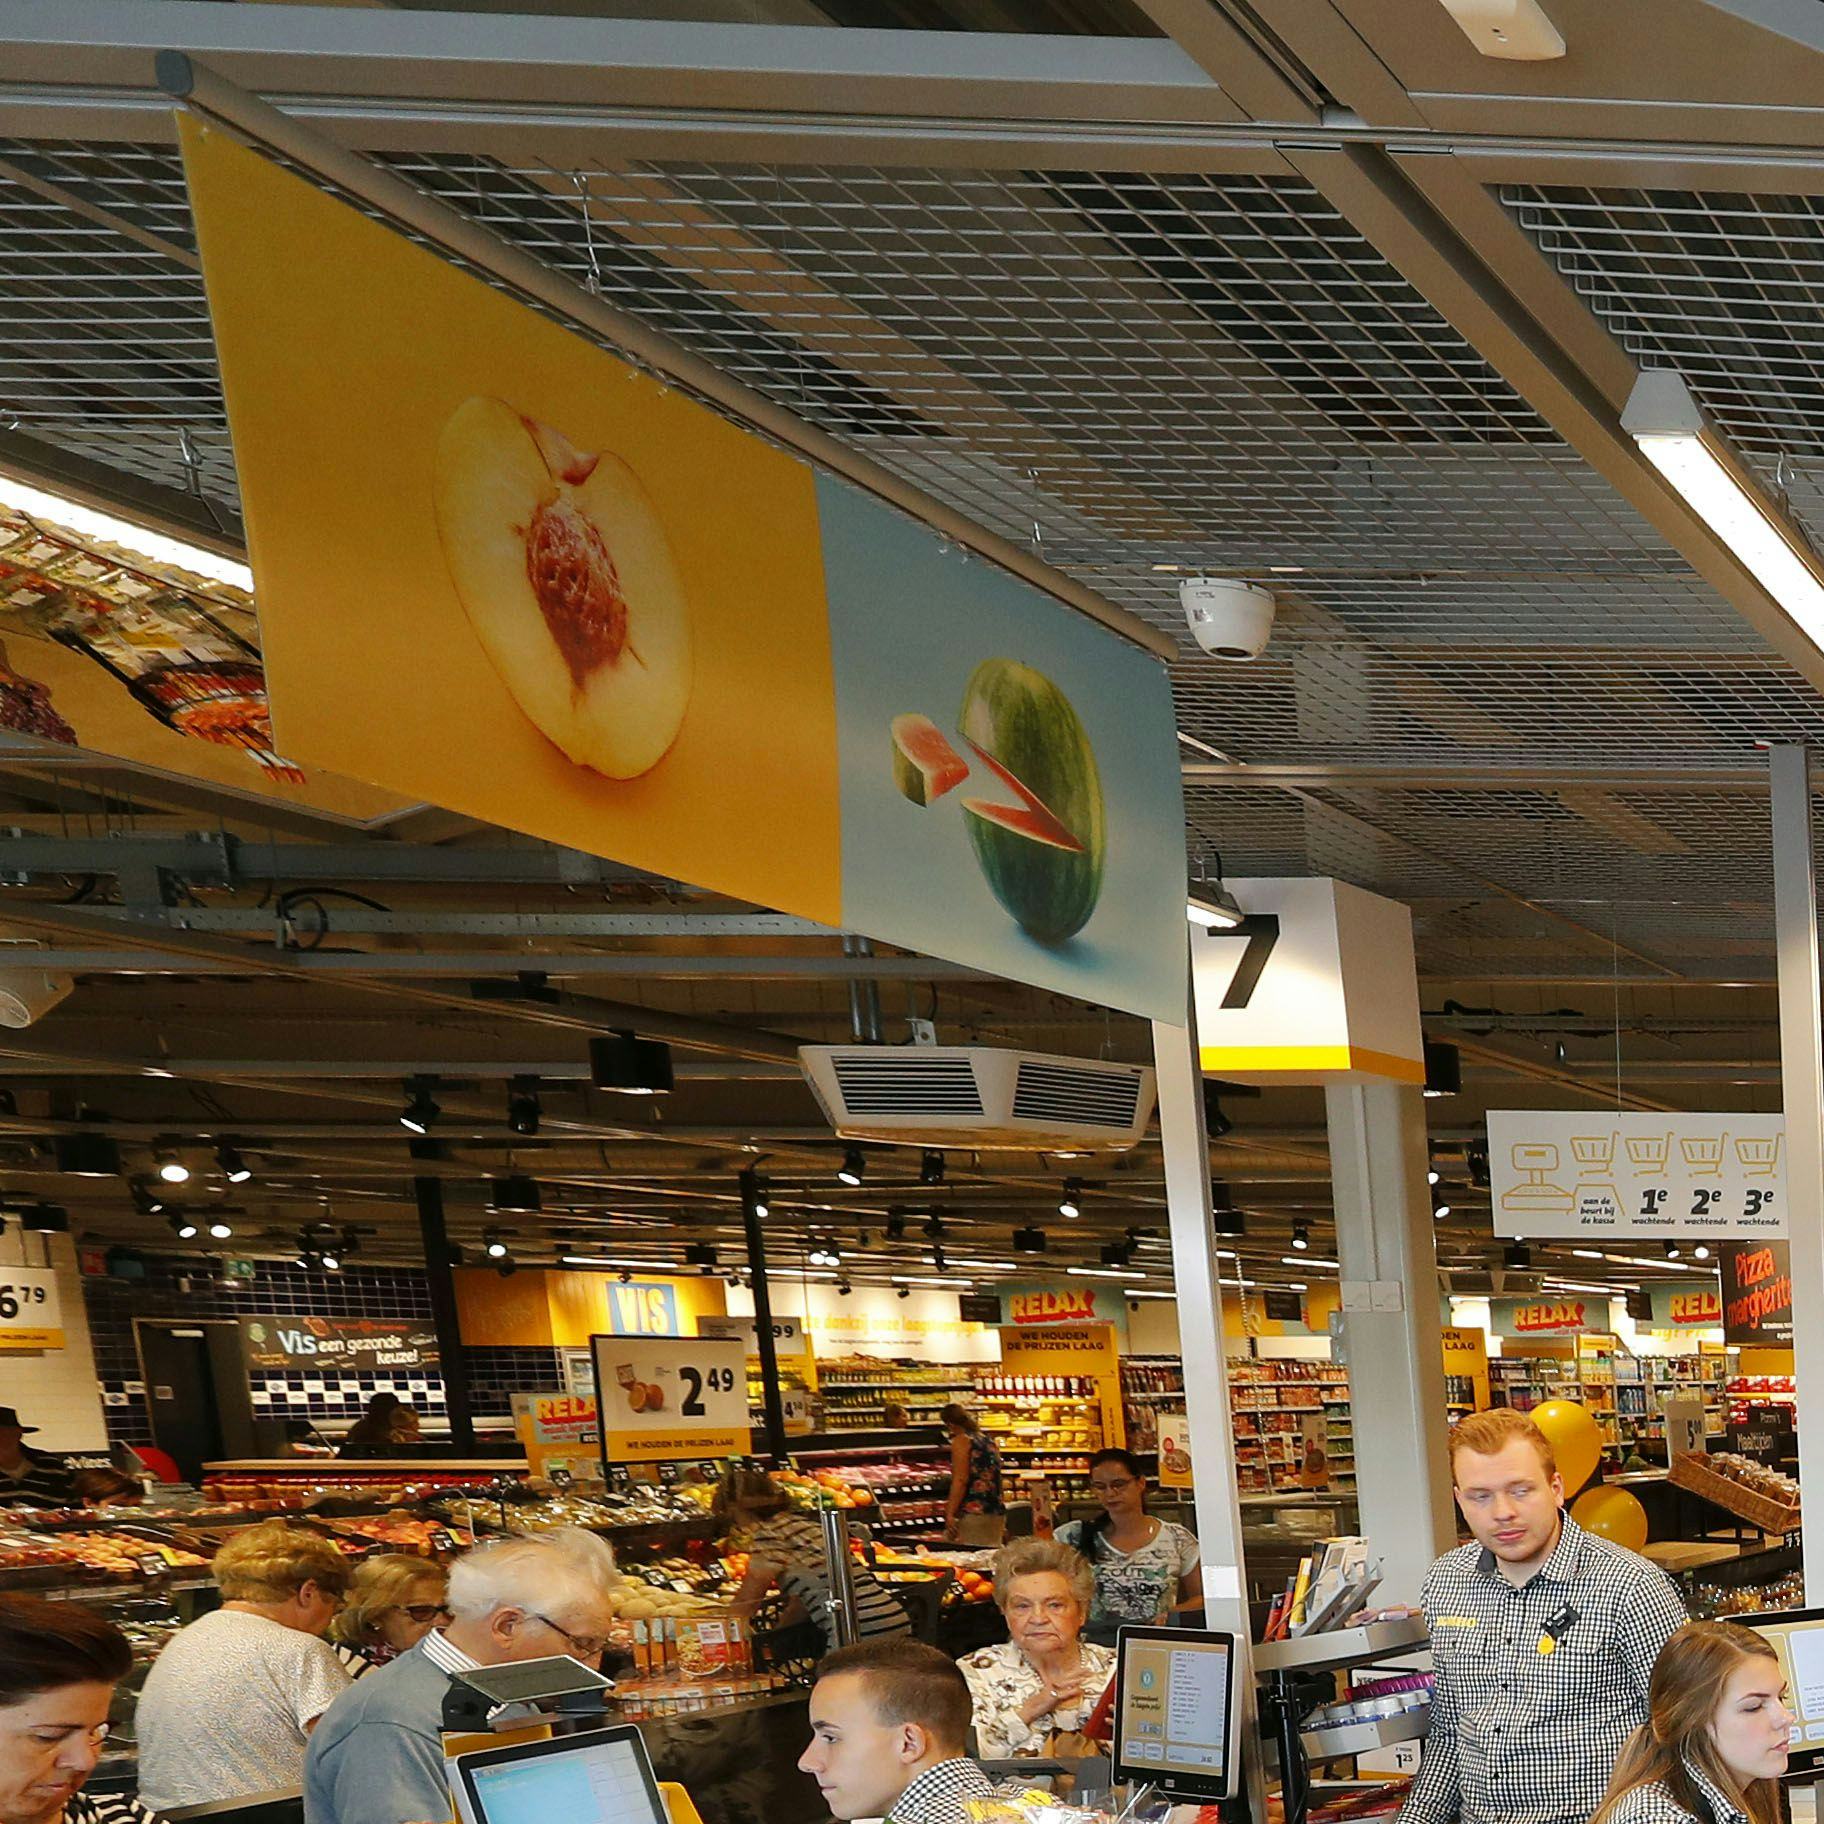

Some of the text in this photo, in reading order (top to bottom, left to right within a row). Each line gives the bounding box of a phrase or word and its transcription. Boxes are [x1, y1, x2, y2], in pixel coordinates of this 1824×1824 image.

[1207, 914, 1280, 1009] 7
[1631, 1217, 1676, 1225] wachtende
[1684, 1217, 1728, 1226] wachtende
[1736, 1218, 1780, 1226] wachtende
[1735, 1248, 1776, 1288] Pizza
[615, 1287, 670, 1334] VIS
[1009, 1289, 1096, 1323] RELAX
[1513, 1302, 1585, 1331] RELAX
[277, 1329, 402, 1355] Vis een gezonde
[1020, 1331, 1089, 1340] WE HOUDEN
